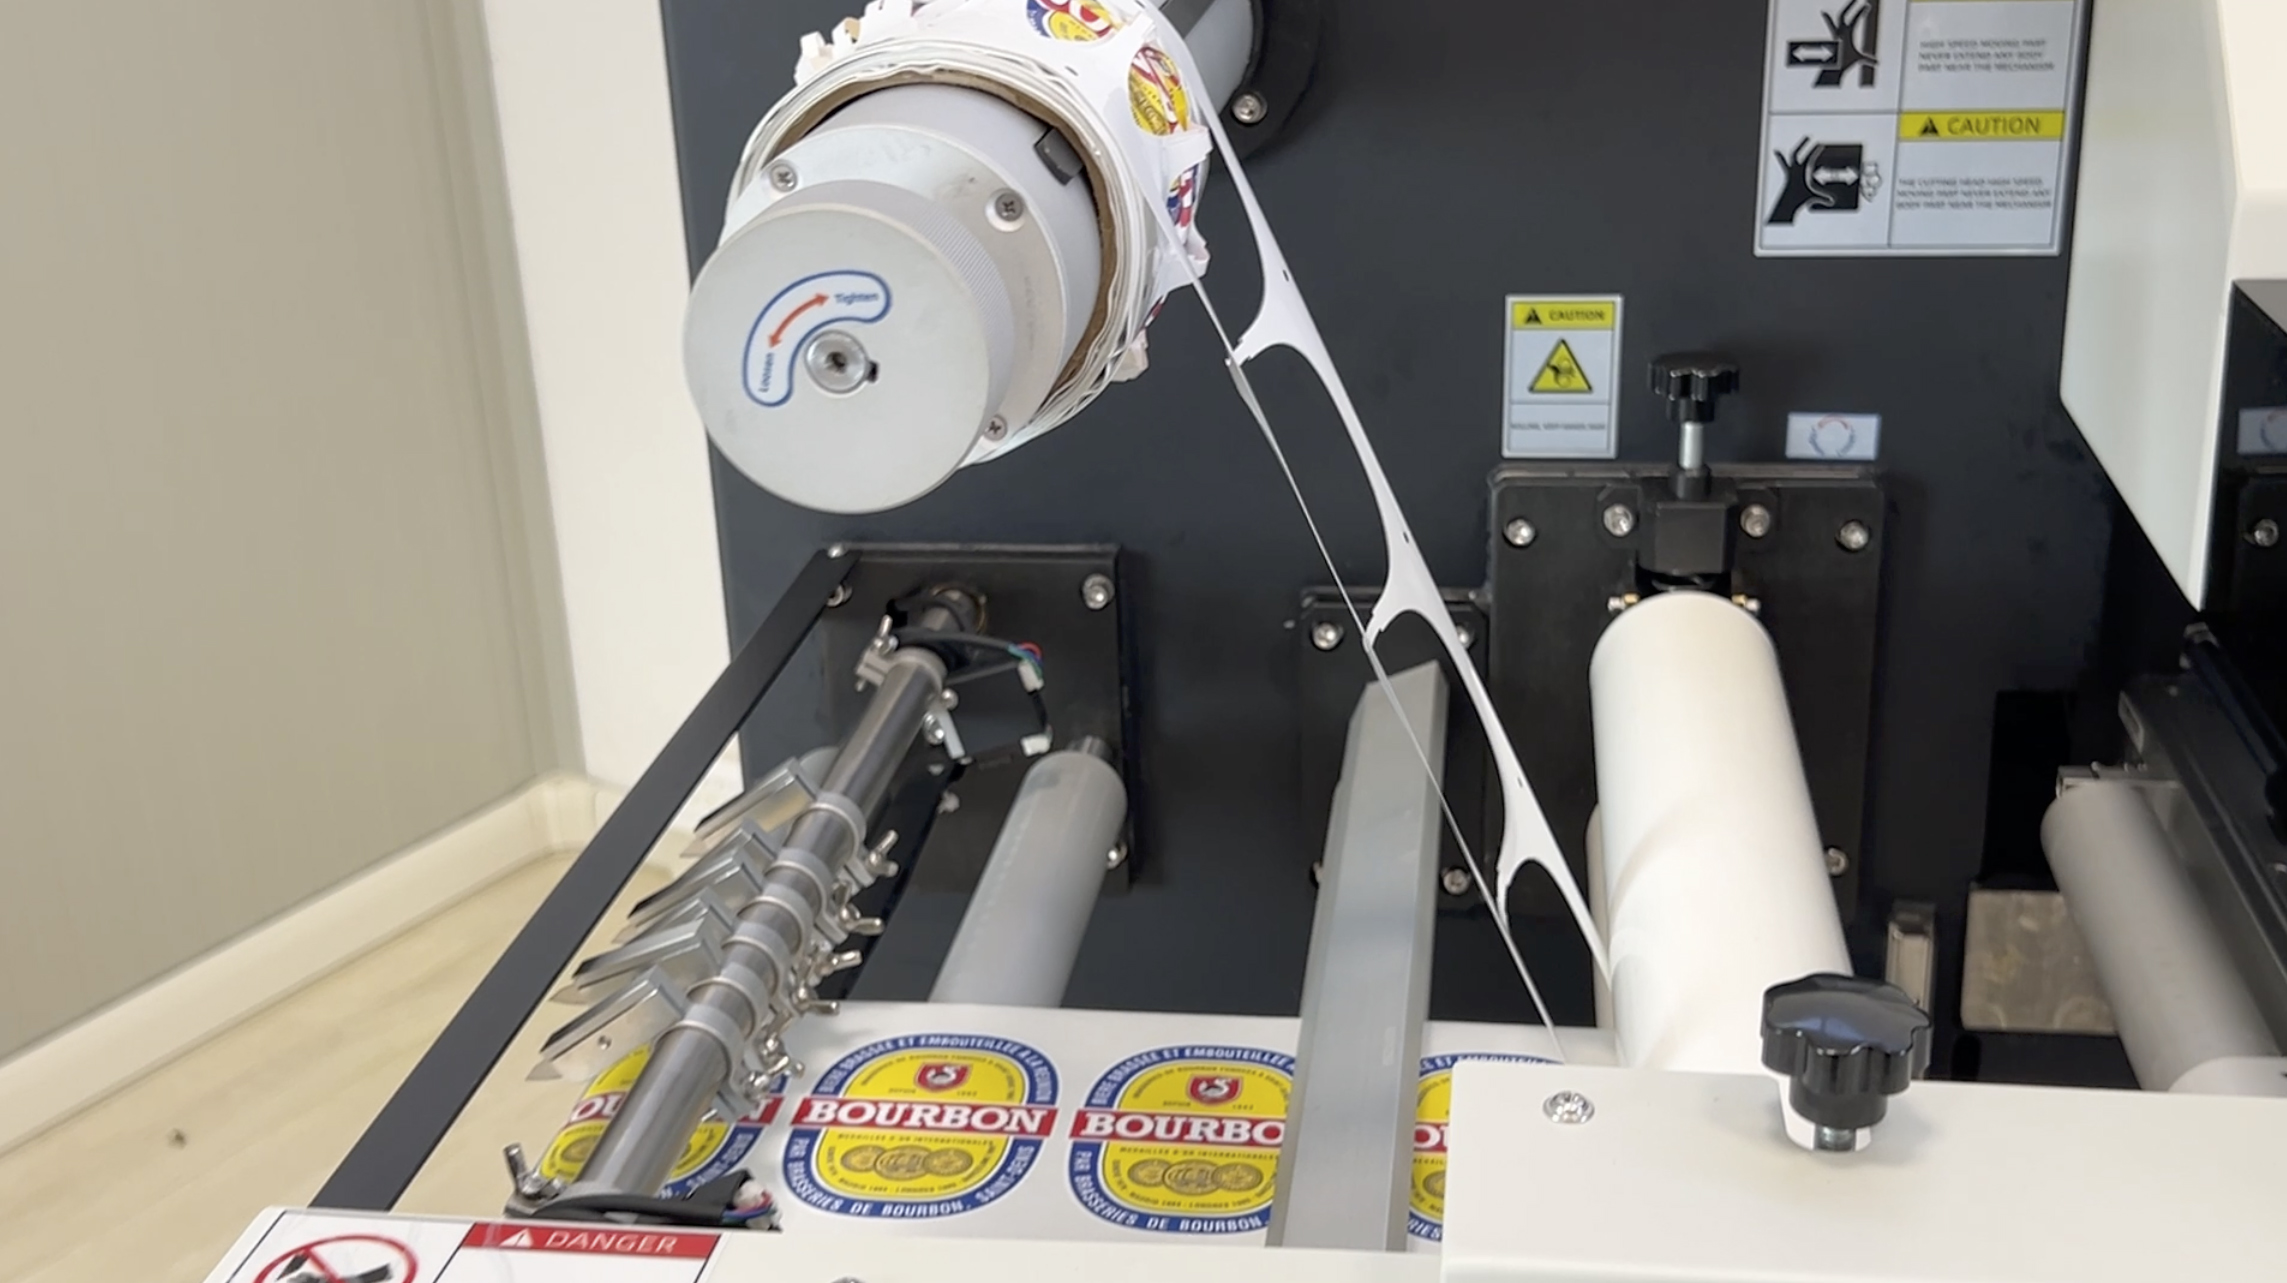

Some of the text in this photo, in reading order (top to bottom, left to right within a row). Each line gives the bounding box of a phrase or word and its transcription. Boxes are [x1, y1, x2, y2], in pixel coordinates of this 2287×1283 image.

[1947, 117, 2041, 136] CAUTION
[1549, 309, 1605, 322] CAUTION
[802, 1099, 1048, 1132] BOURBON
[1080, 1111, 1286, 1145] BOURBO
[850, 1201, 872, 1214] DE
[1147, 1217, 1170, 1230] DE
[544, 1229, 678, 1253] DANGER
